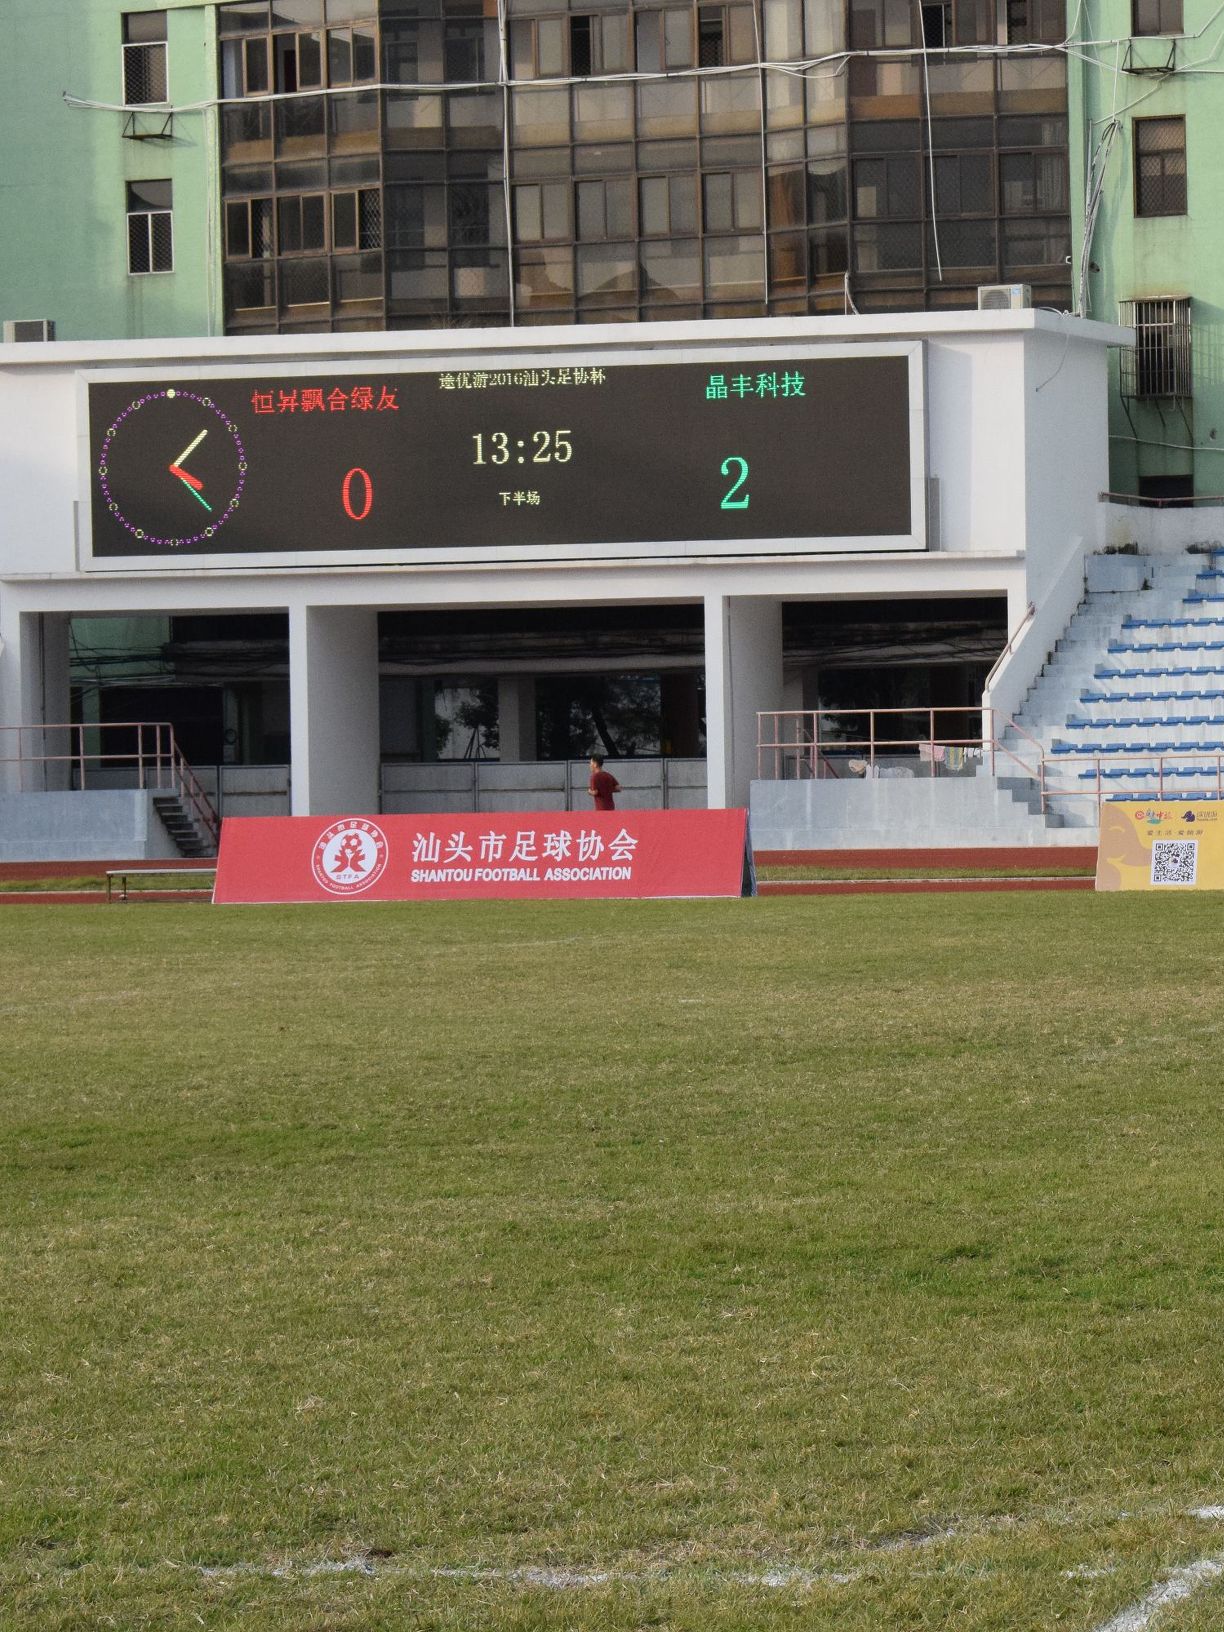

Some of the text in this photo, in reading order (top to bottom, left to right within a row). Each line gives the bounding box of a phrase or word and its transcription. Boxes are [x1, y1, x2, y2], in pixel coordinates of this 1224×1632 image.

[706, 371, 807, 399] 晶丰科技
[472, 430, 573, 465] 13:25
[342, 467, 373, 520] 0
[498, 490, 541, 506] 下半场
[720, 456, 750, 510] 2
[411, 828, 639, 864] 汕头市足球协会
[411, 867, 632, 883] SHANTOU FOOTBALL ASSOCIATION
